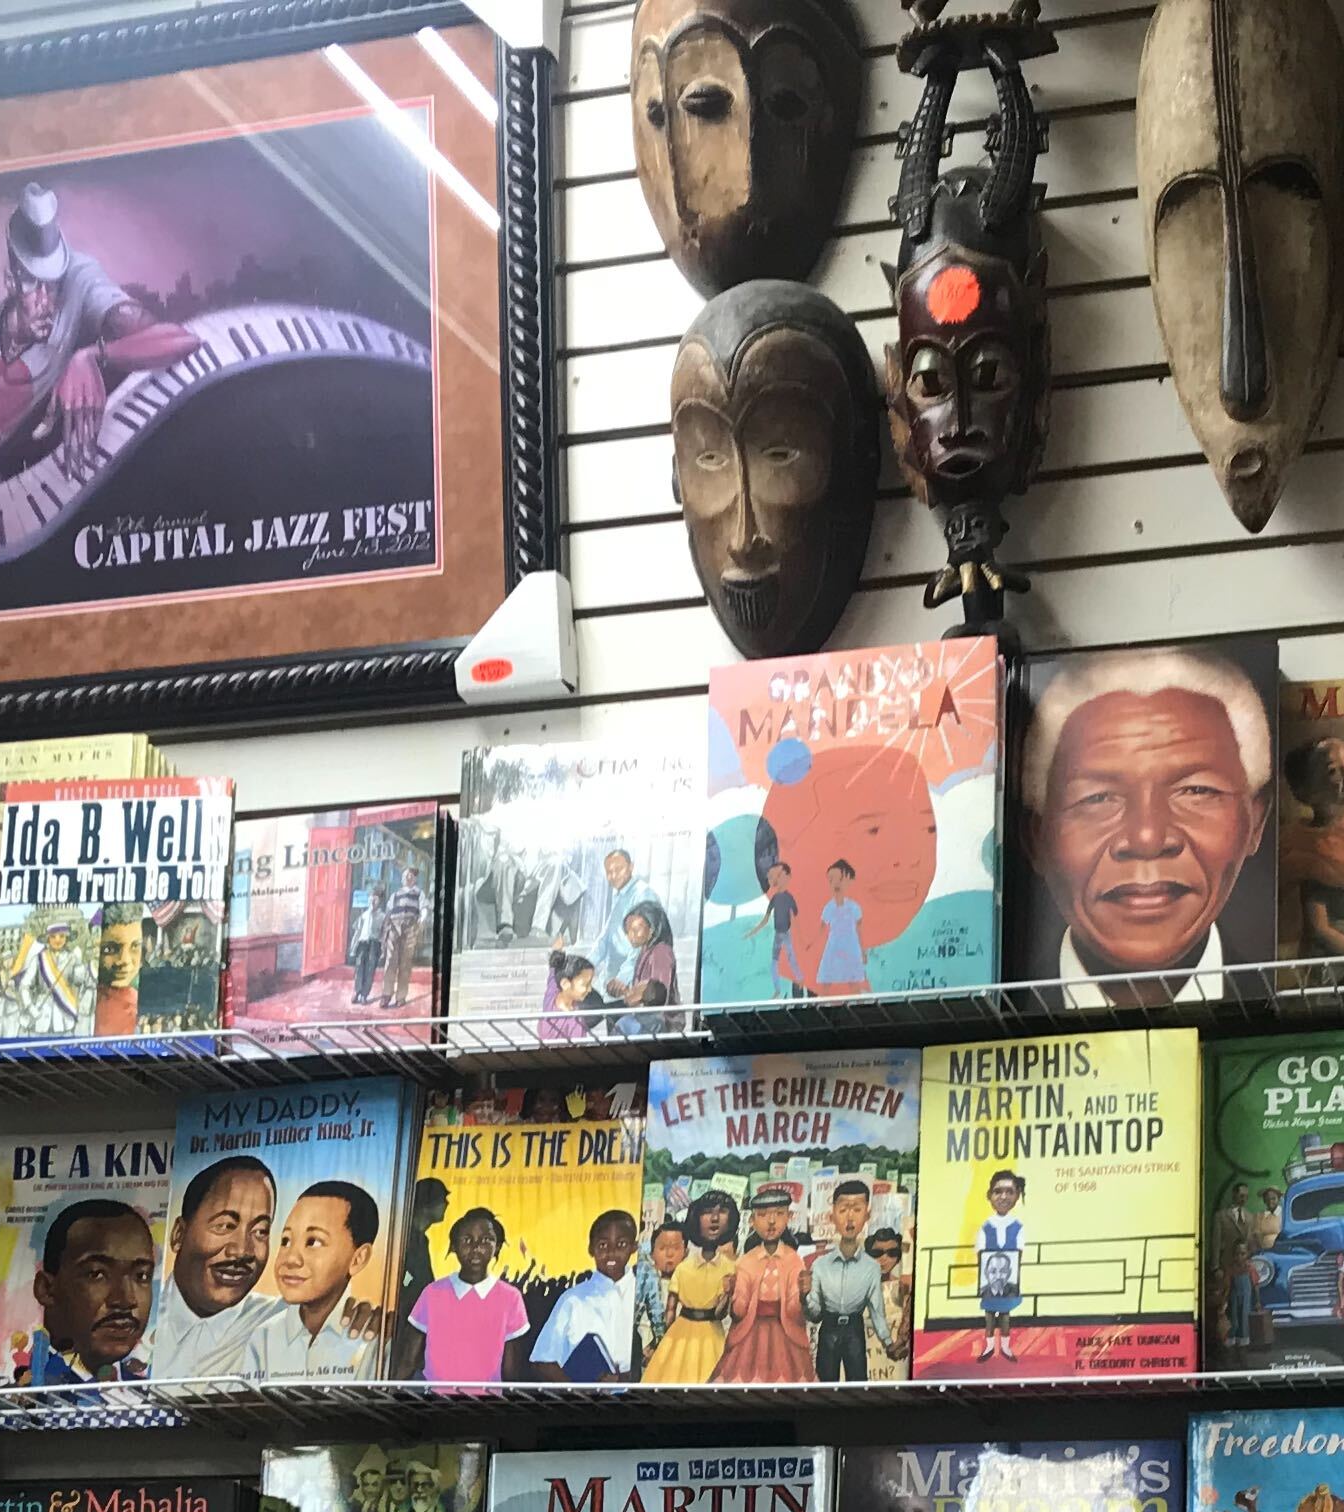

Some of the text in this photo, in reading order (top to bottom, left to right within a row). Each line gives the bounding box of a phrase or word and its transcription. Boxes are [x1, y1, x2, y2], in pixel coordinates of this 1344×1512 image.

[74, 523, 234, 570] CAPITAL
[244, 510, 330, 551] JAZZ
[343, 499, 433, 540] FEST
[2, 802, 111, 868] Ida B.
[0, 864, 223, 903] Let the Truth Be Told
[948, 1041, 1100, 1086] MEMPHIS,
[205, 1090, 362, 1130] MY DADDY,
[661, 1078, 905, 1127] LET THE CHILDREN
[947, 1083, 1159, 1123] MARTIN, AND THE
[190, 1135, 207, 1154] Dr.
[212, 1132, 260, 1152] Martin
[265, 1127, 311, 1147] Luther
[725, 1110, 831, 1149] MARCH
[945, 1117, 1165, 1164] MOUNTAINTOP
[427, 1131, 568, 1169] THIS IS THE
[1055, 1161, 1181, 1178] THE SANITATION STRIKE
[1055, 1181, 1098, 1194] OF 1968
[637, 1458, 813, 1481] my brother
